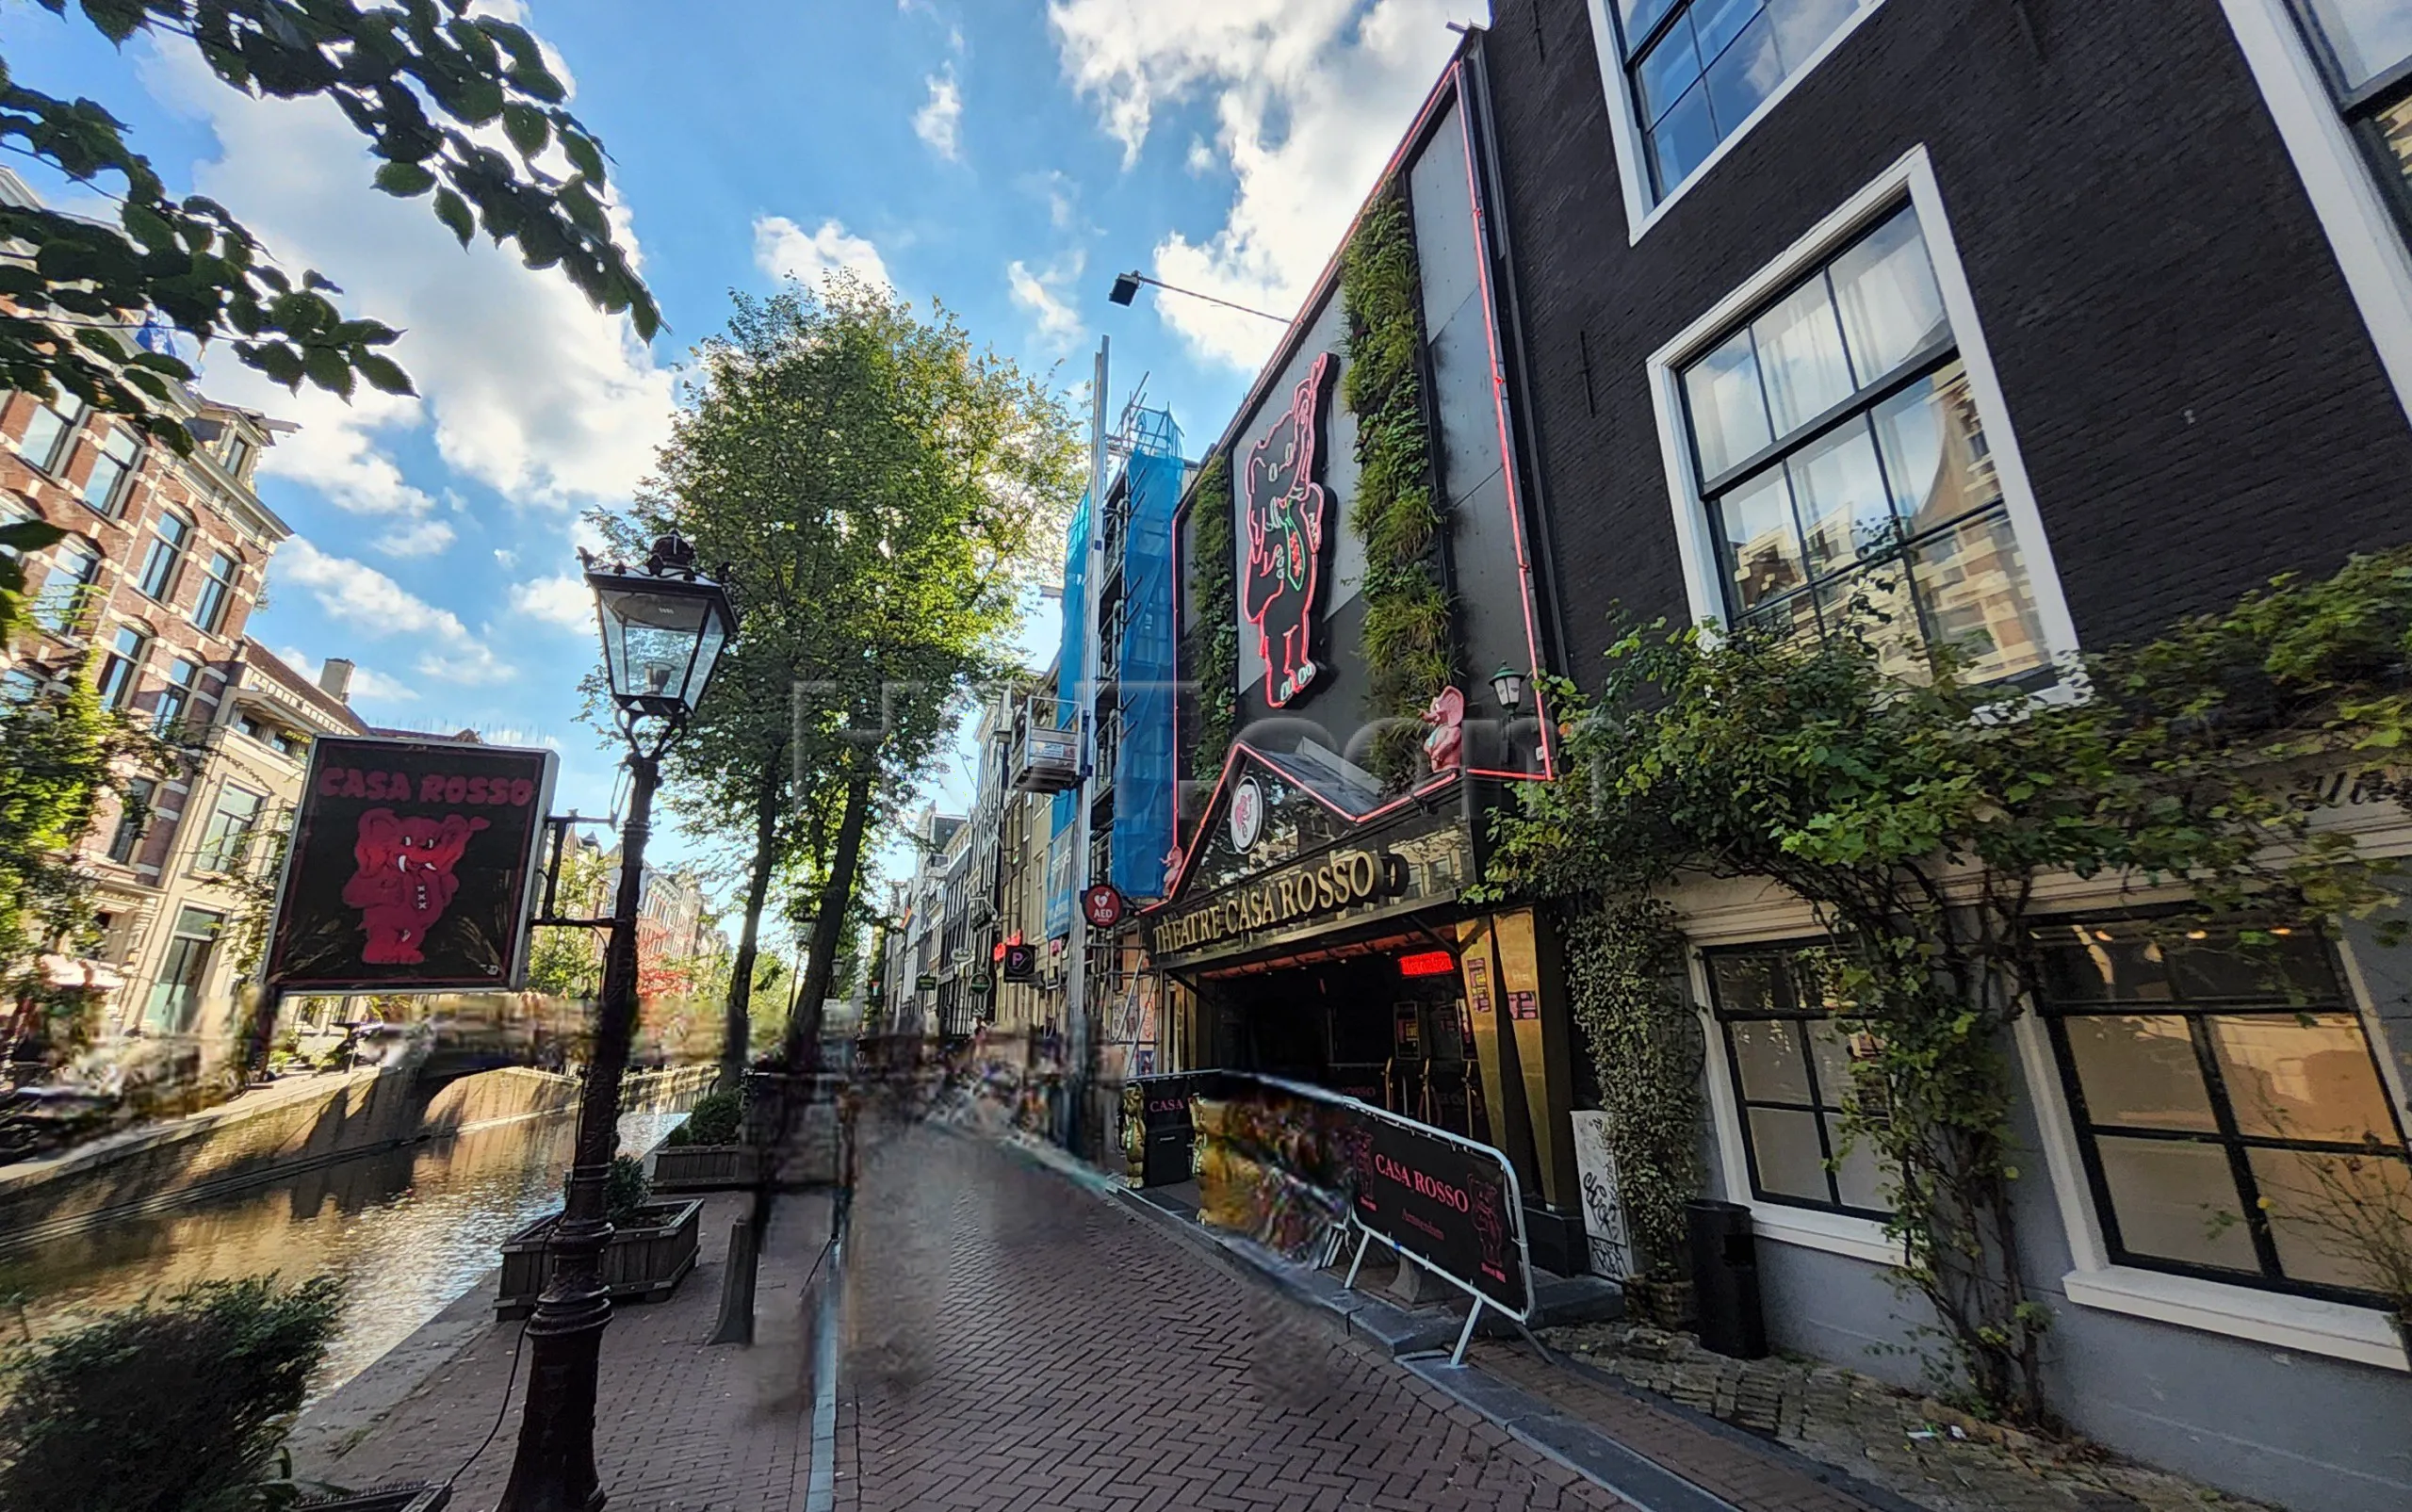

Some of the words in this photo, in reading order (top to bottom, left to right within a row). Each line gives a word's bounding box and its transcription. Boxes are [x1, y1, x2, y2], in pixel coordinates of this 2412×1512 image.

[318, 767, 412, 802] CASA
[418, 773, 534, 807] ROSSO
[1225, 886, 1277, 935] CASA
[1279, 851, 1375, 919] ROSSO
[1094, 908, 1113, 919] AED
[1149, 1098, 1184, 1113] CASA
[1376, 1153, 1411, 1188] CASA
[1413, 1170, 1469, 1213] ROSSO
